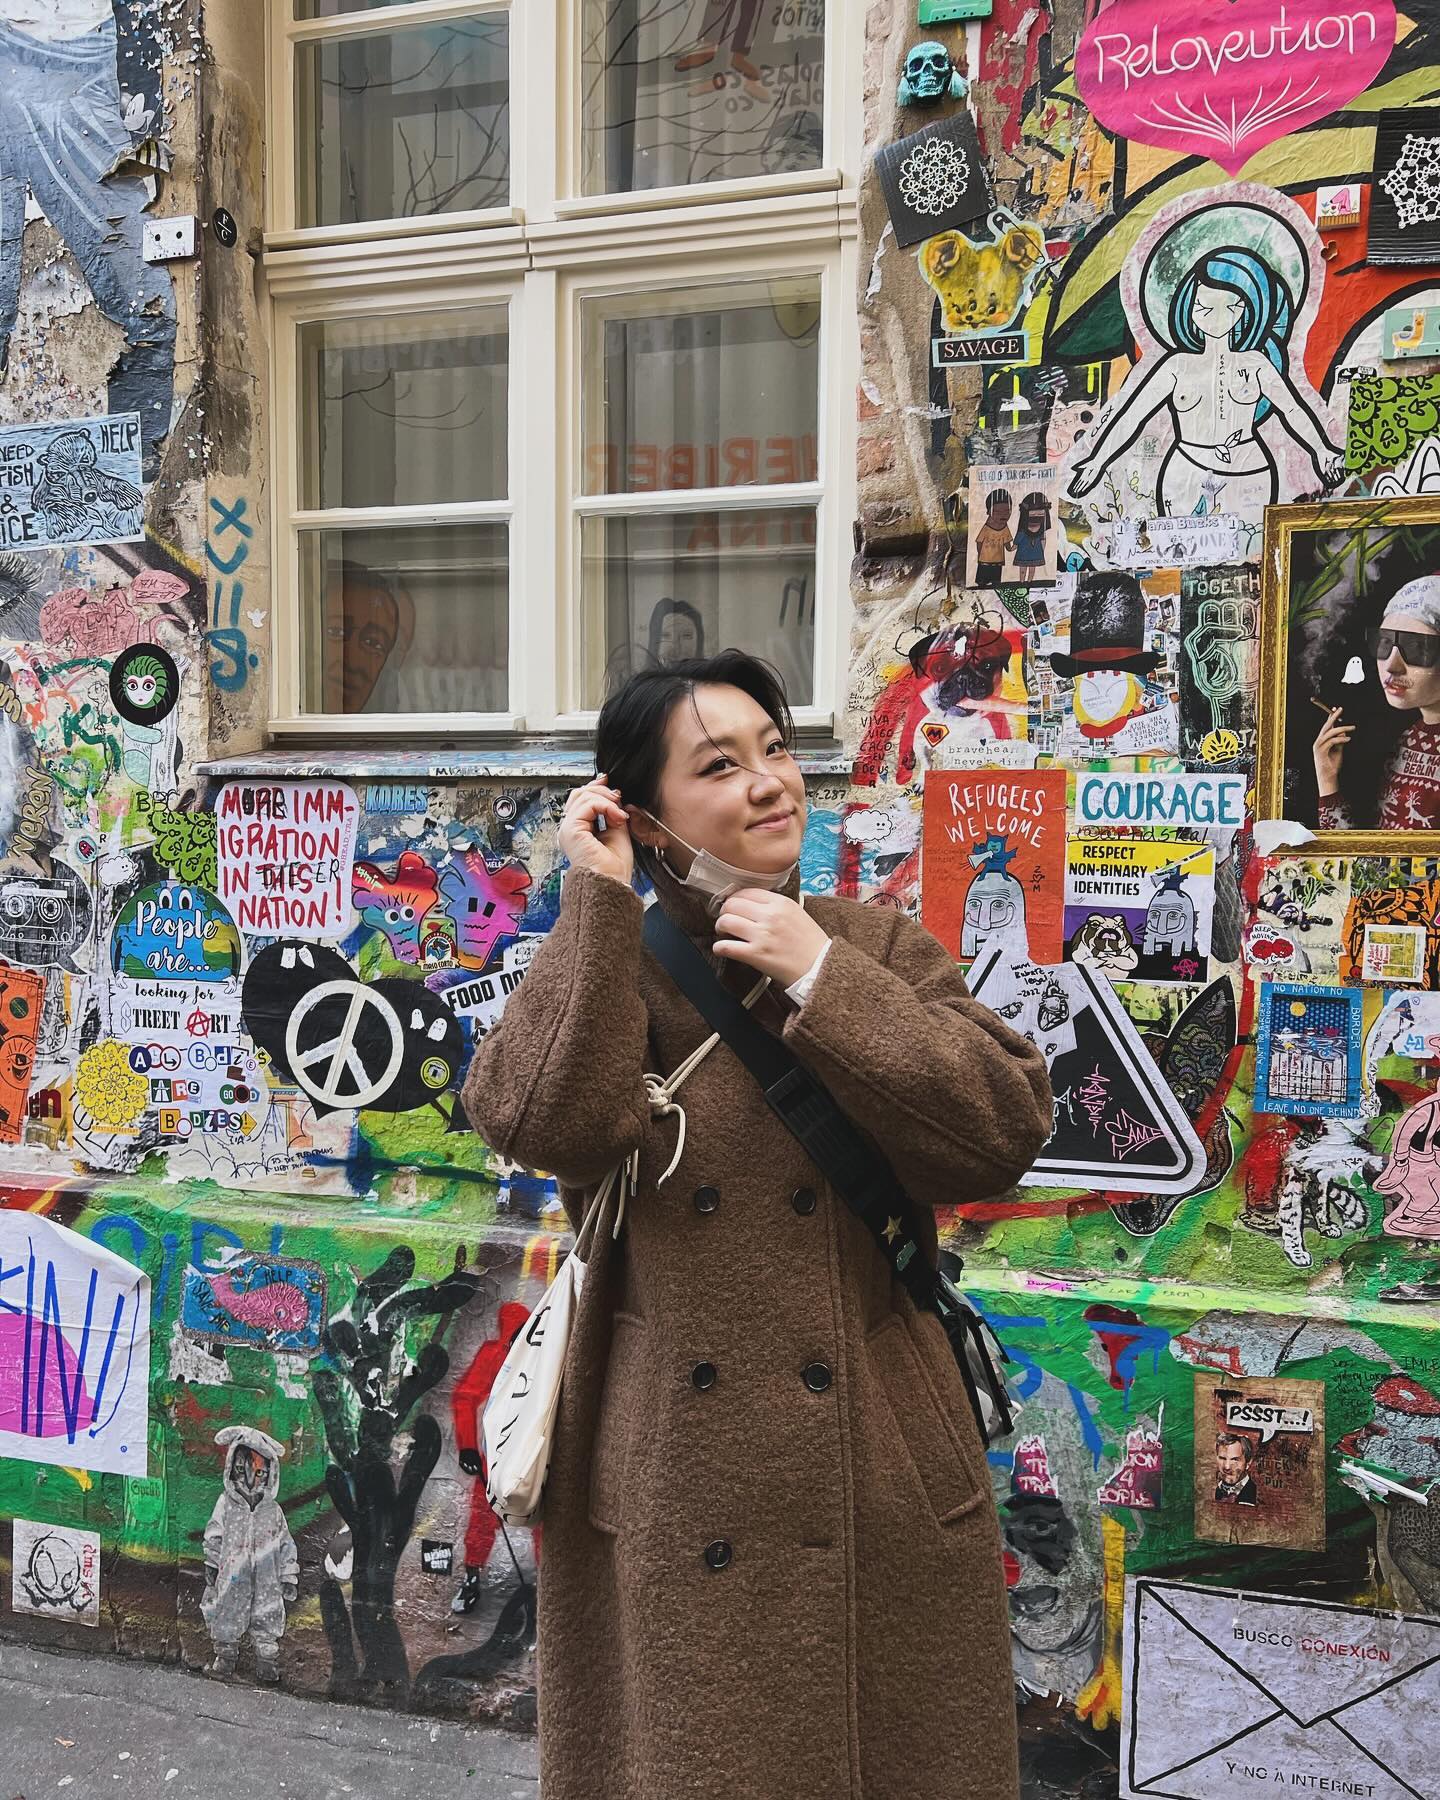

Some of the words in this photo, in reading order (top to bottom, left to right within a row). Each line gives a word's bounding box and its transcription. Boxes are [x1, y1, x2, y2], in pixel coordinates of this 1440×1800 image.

[944, 339, 1019, 358] SAVAGE
[101, 422, 138, 454] HELP
[1402, 749, 1426, 765] CHILL
[1403, 763, 1437, 779] BERLIN
[948, 782, 1046, 817] REFUGEES
[1082, 779, 1240, 824] COURAGE
[220, 823, 340, 862] IGRATION
[944, 813, 1047, 849] WELCOME
[1082, 845, 1135, 860] RESPECT
[224, 861, 250, 898] IN
[1069, 864, 1148, 879] NON-BINARY
[1074, 881, 1140, 896] IDENTITIES
[136, 899, 218, 949] People
[1252, 933, 1275, 941] MOVING
[1254, 925, 1272, 933] KEEP
[146, 946, 210, 971] are...
[136, 982, 189, 1004] looking
[193, 985, 216, 1005] for
[447, 980, 496, 1011] FOOD
[500, 968, 528, 996] NO
[1274, 984, 1286, 993] NO
[1292, 985, 1325, 994] NATION
[1330, 987, 1343, 996] NO
[121, 1001, 181, 1033] STREET
[185, 1004, 231, 1039] ART
[1351, 1007, 1361, 1049] BORDER
[1264, 1103, 1289, 1113] LEAVE
[1293, 1105, 1306, 1114] NO
[1309, 1107, 1324, 1115] ONE
[1329, 1108, 1361, 1118] BEHIND
[264, 1269, 292, 1284] HELP
[192, 1281, 213, 1312] SAVE
[1233, 1627, 1293, 1648] BUSCO
[1301, 1638, 1391, 1662] CONEXIÓN
[1226, 1762, 1236, 1774] Y
[1244, 1765, 1268, 1780] NO
[1292, 1773, 1376, 1798] INTERNET
